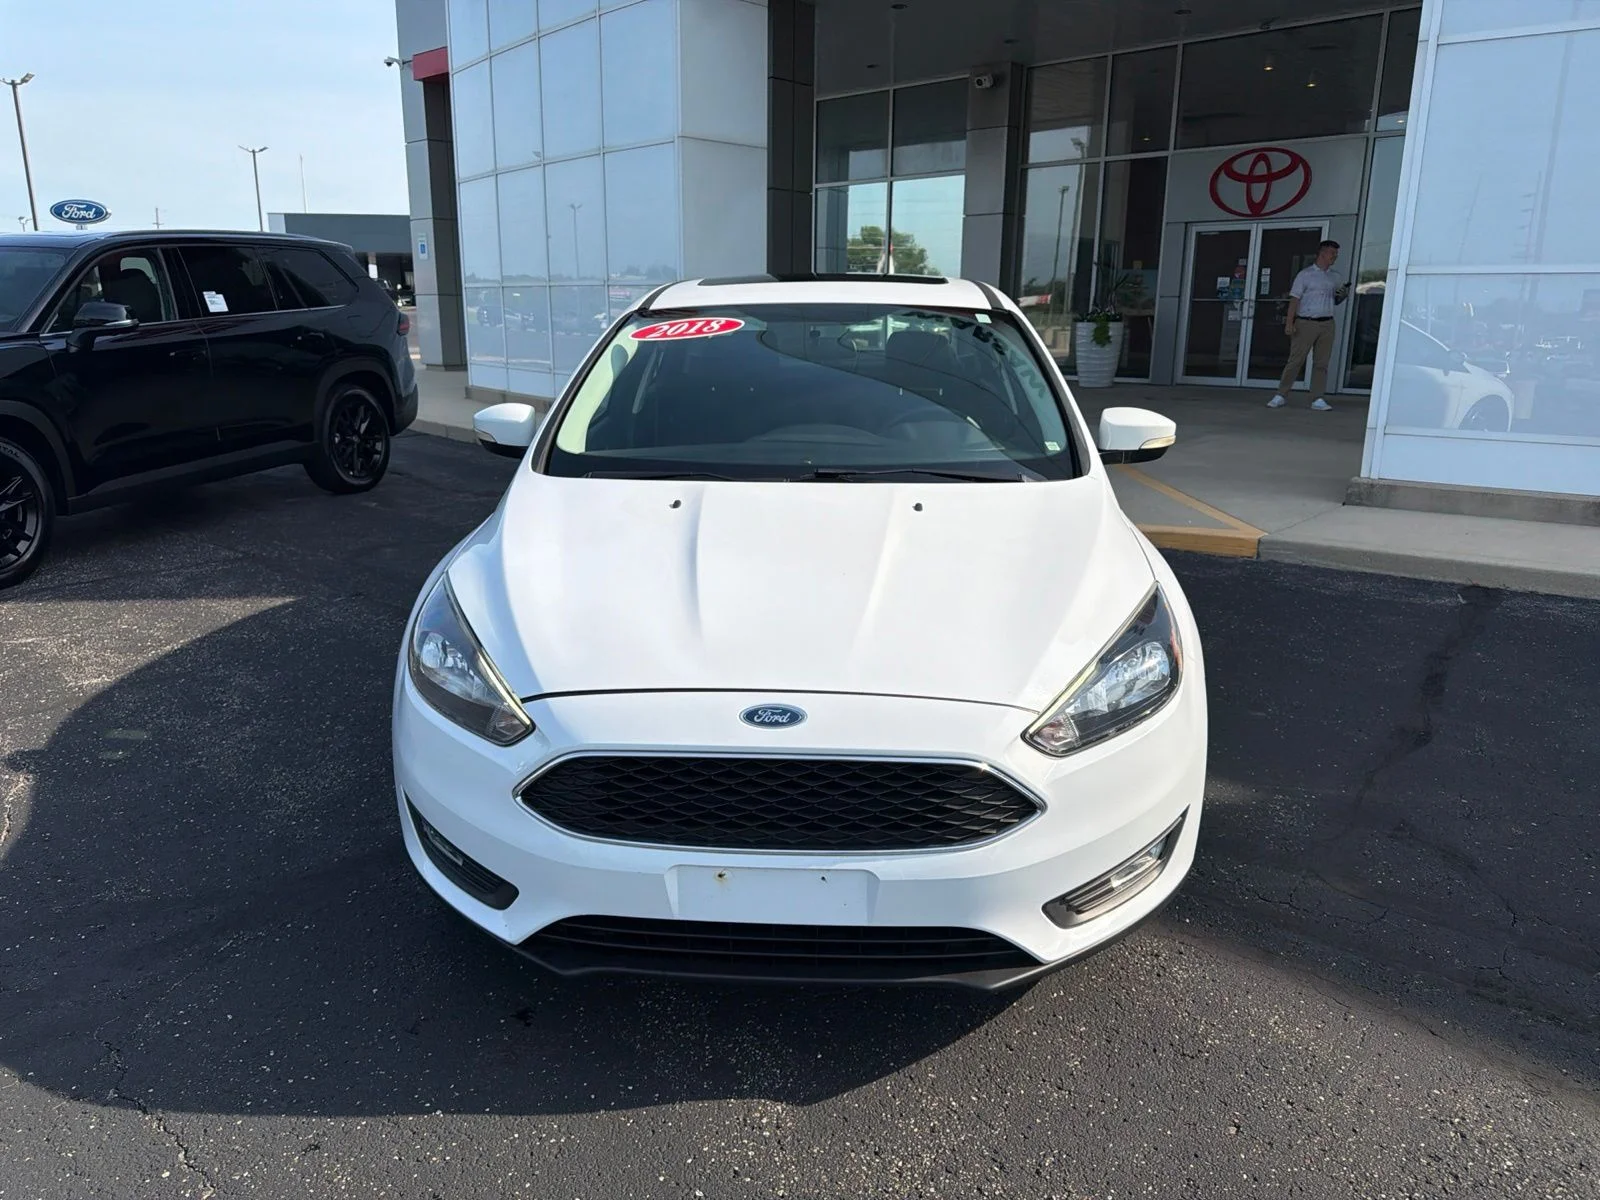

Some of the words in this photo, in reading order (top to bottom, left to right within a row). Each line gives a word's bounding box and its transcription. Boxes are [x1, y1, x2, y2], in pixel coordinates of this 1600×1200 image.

[61, 203, 96, 219] Ford
[646, 319, 727, 338] 2018
[753, 709, 791, 723] Ford
